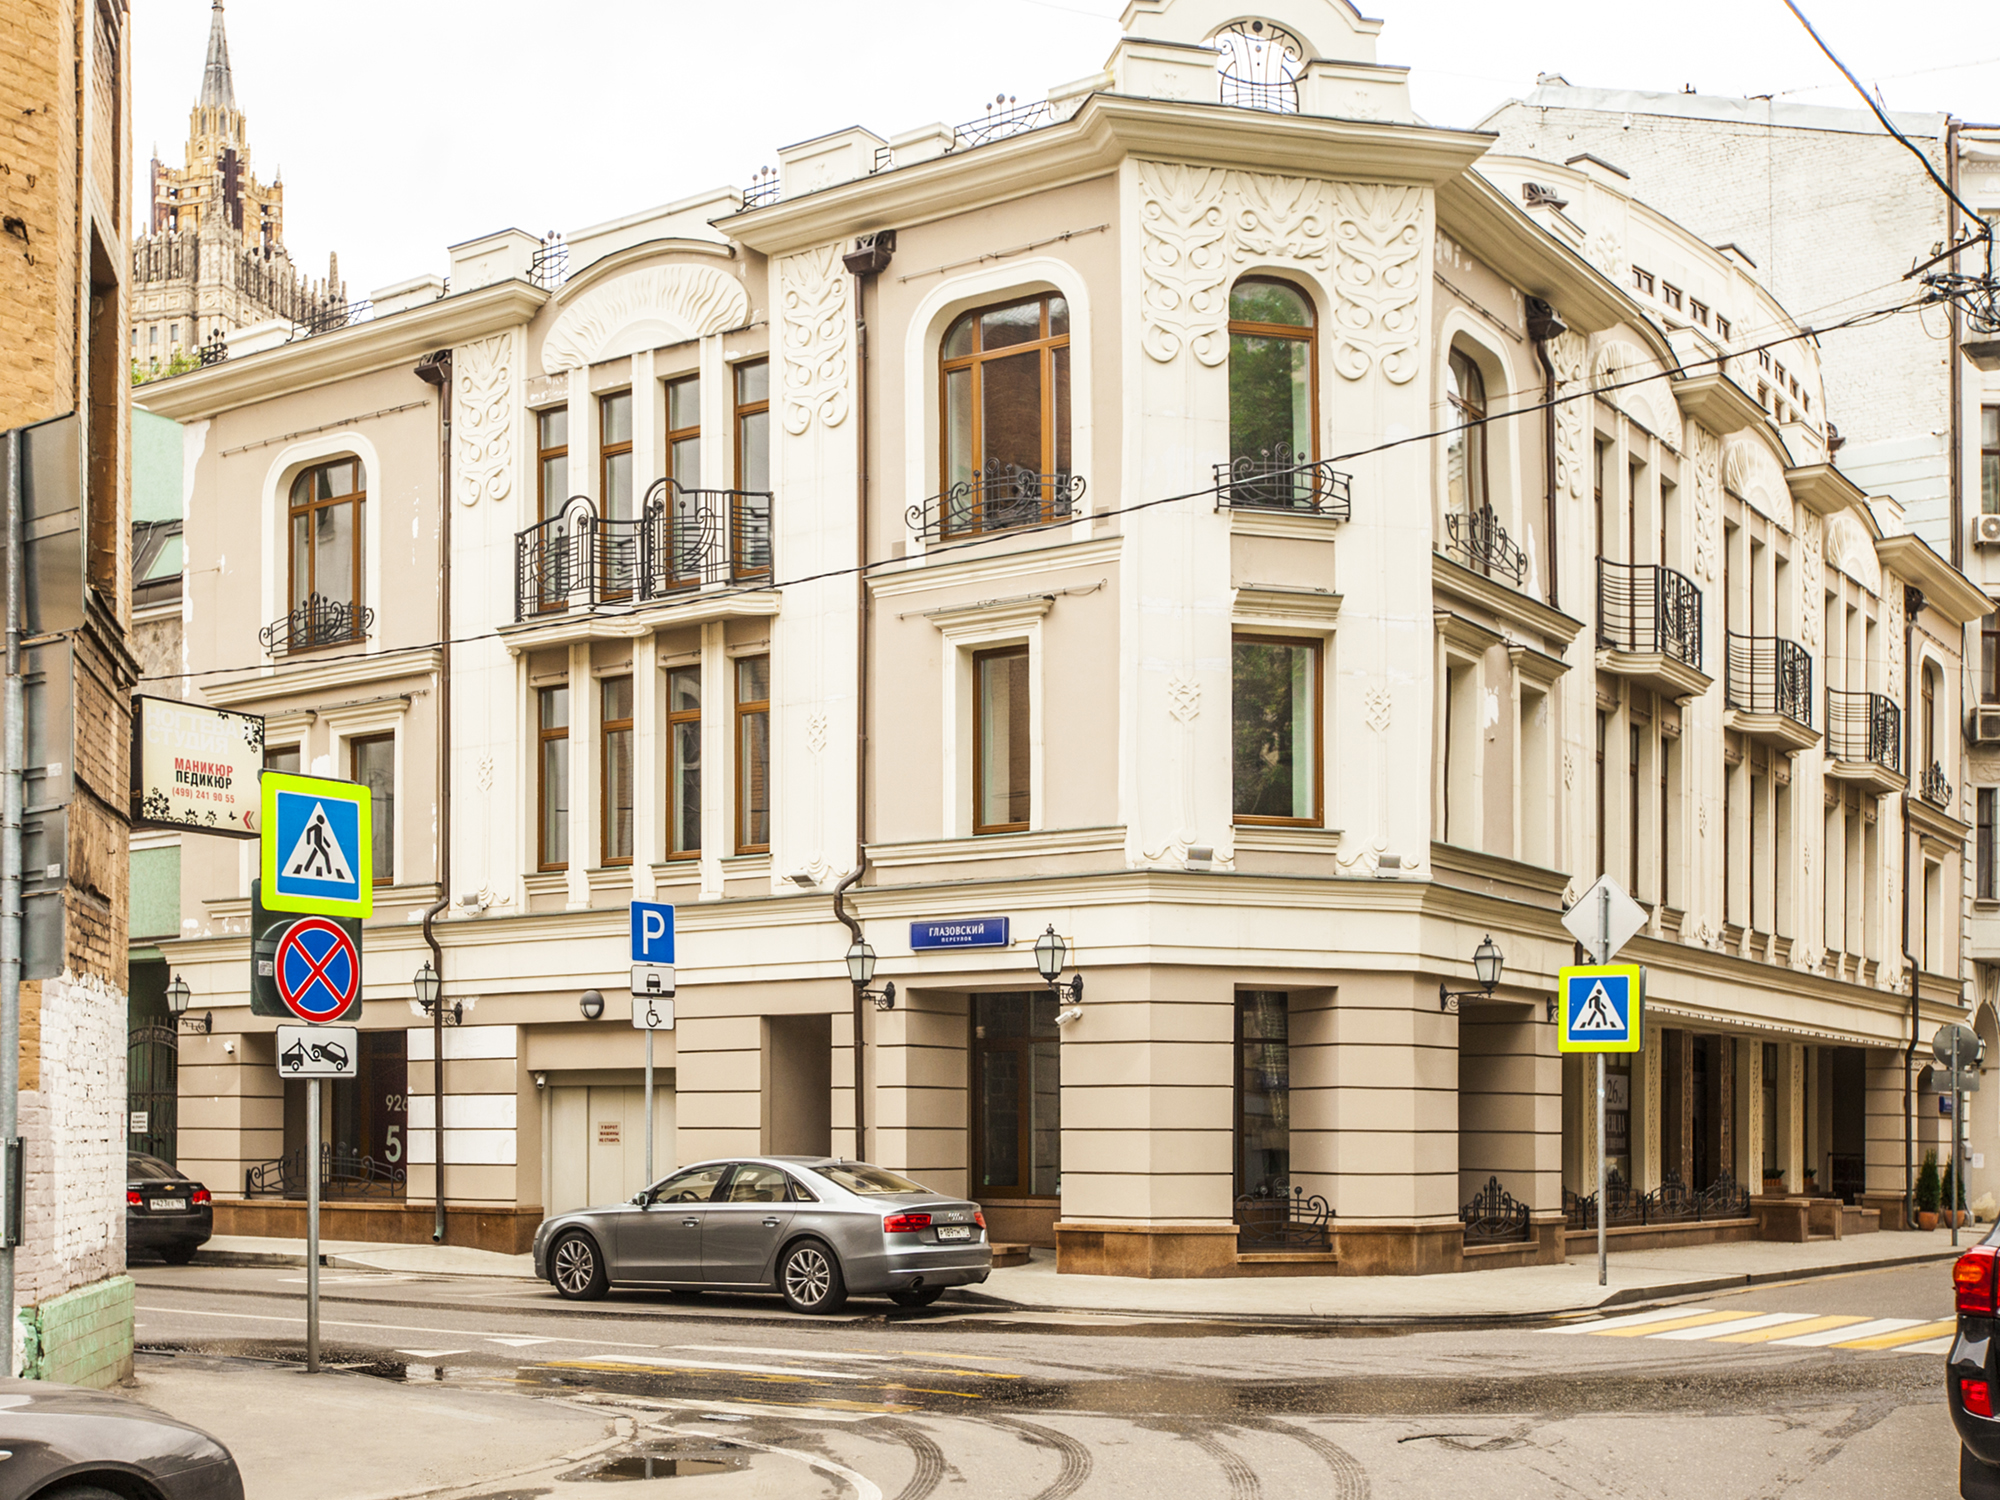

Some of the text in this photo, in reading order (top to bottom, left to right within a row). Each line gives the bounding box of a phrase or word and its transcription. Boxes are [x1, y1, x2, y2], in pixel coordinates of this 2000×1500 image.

[145, 724, 229, 755] СТУДИЯ
[174, 757, 233, 777] МАНИКЮР
[176, 770, 232, 789] ПЕДИКЮР
[172, 787, 235, 804] (499) 241 90 55
[642, 909, 665, 955] P
[929, 923, 985, 937] ГЛАЗОВСКИЙ
[1606, 1079, 1619, 1104] 26
[1606, 1114, 1626, 1134] ЕНДА
[384, 1125, 402, 1163] 5
